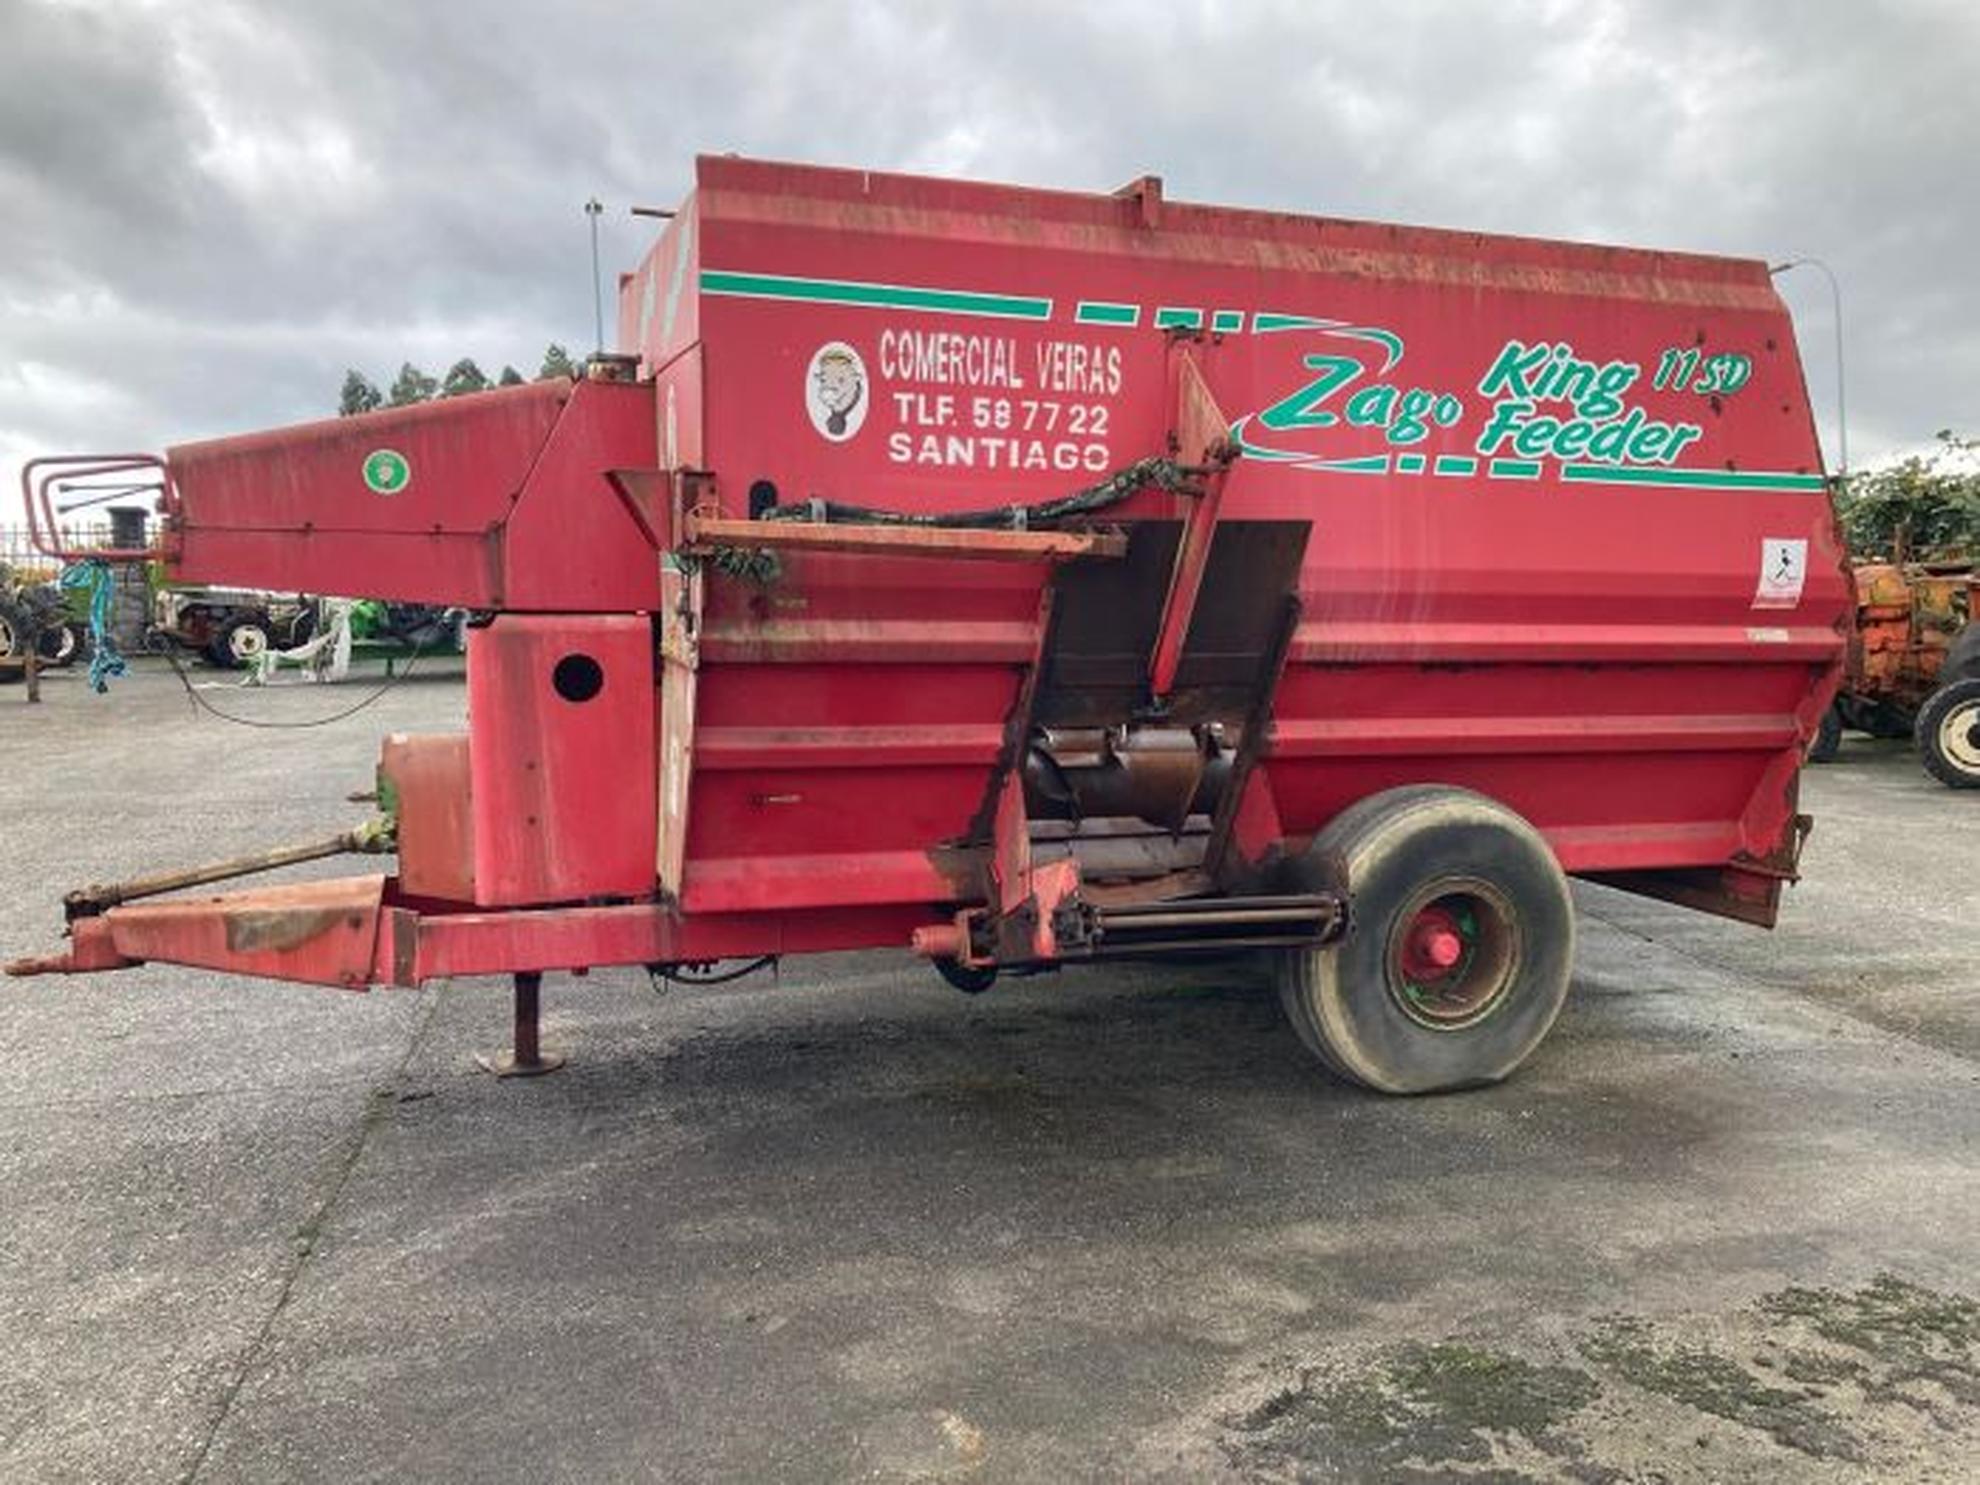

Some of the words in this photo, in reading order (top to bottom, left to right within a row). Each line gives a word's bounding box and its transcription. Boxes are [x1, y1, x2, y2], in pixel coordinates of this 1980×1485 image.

[879, 329, 1023, 388] COMERCIAL
[1036, 341, 1121, 394] VEIRAS
[1477, 339, 1640, 420] King
[893, 392, 958, 426] TLF.
[1258, 355, 1463, 445] Zago
[1475, 399, 1702, 465] Feeder
[888, 432, 1110, 471] SANTIAGO
